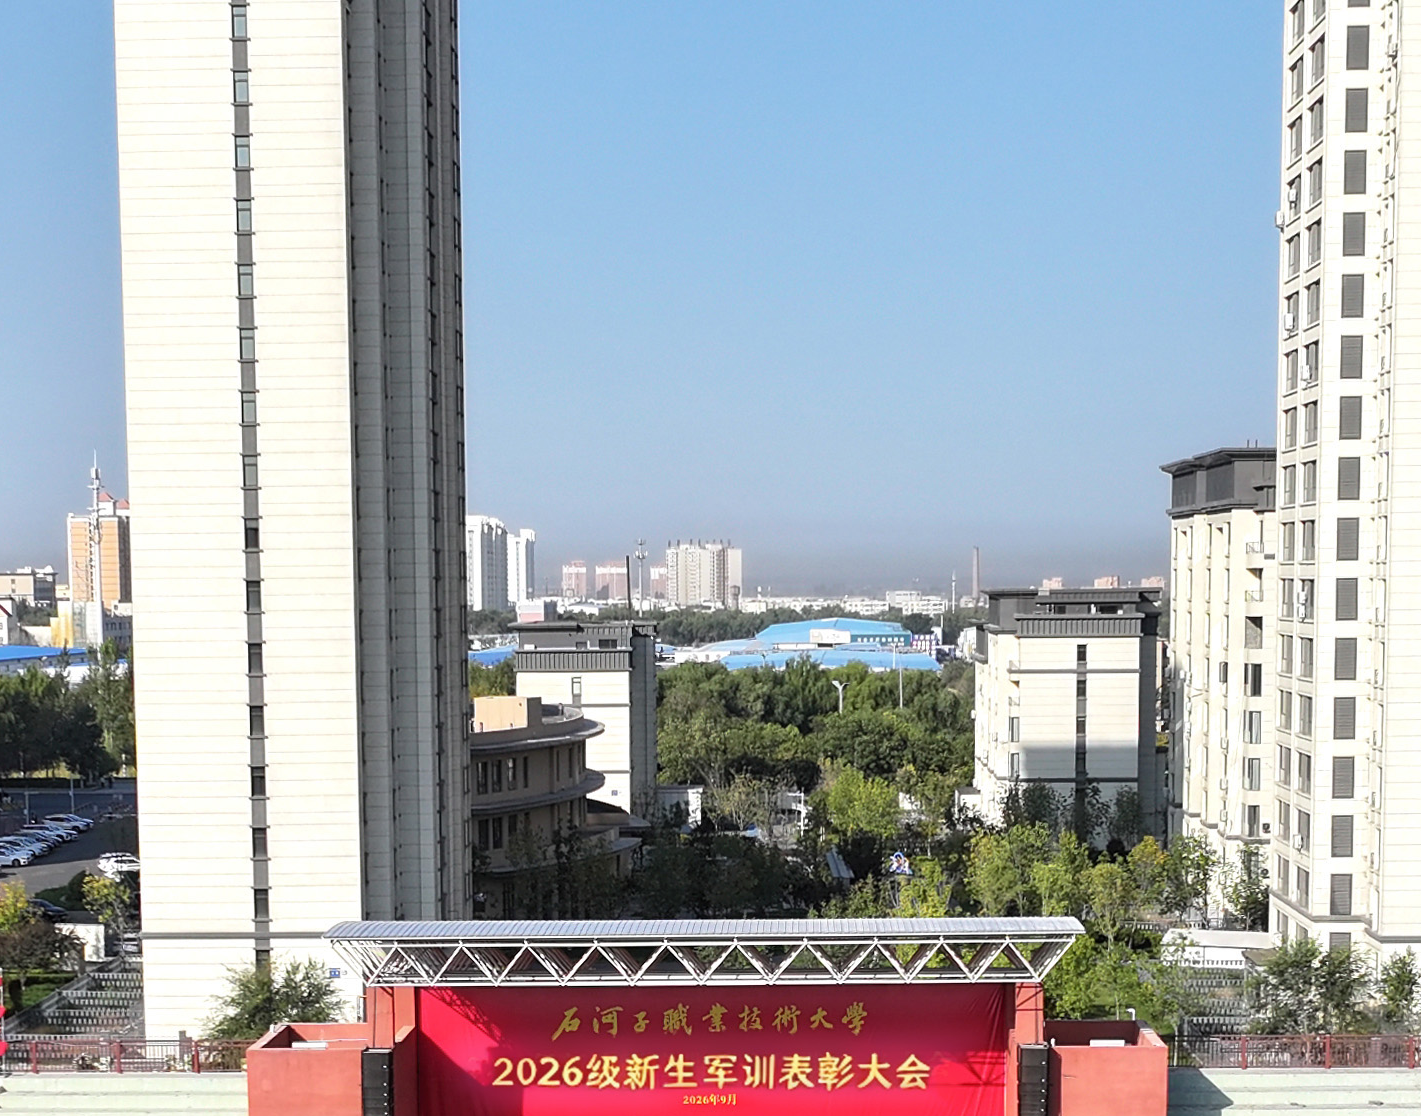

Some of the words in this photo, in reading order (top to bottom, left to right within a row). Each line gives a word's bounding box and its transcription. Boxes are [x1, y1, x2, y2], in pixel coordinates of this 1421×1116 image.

[491, 1052, 931, 1091] 2026级新生军训表彰大会
[682, 1094, 737, 1106] 2026年9月
